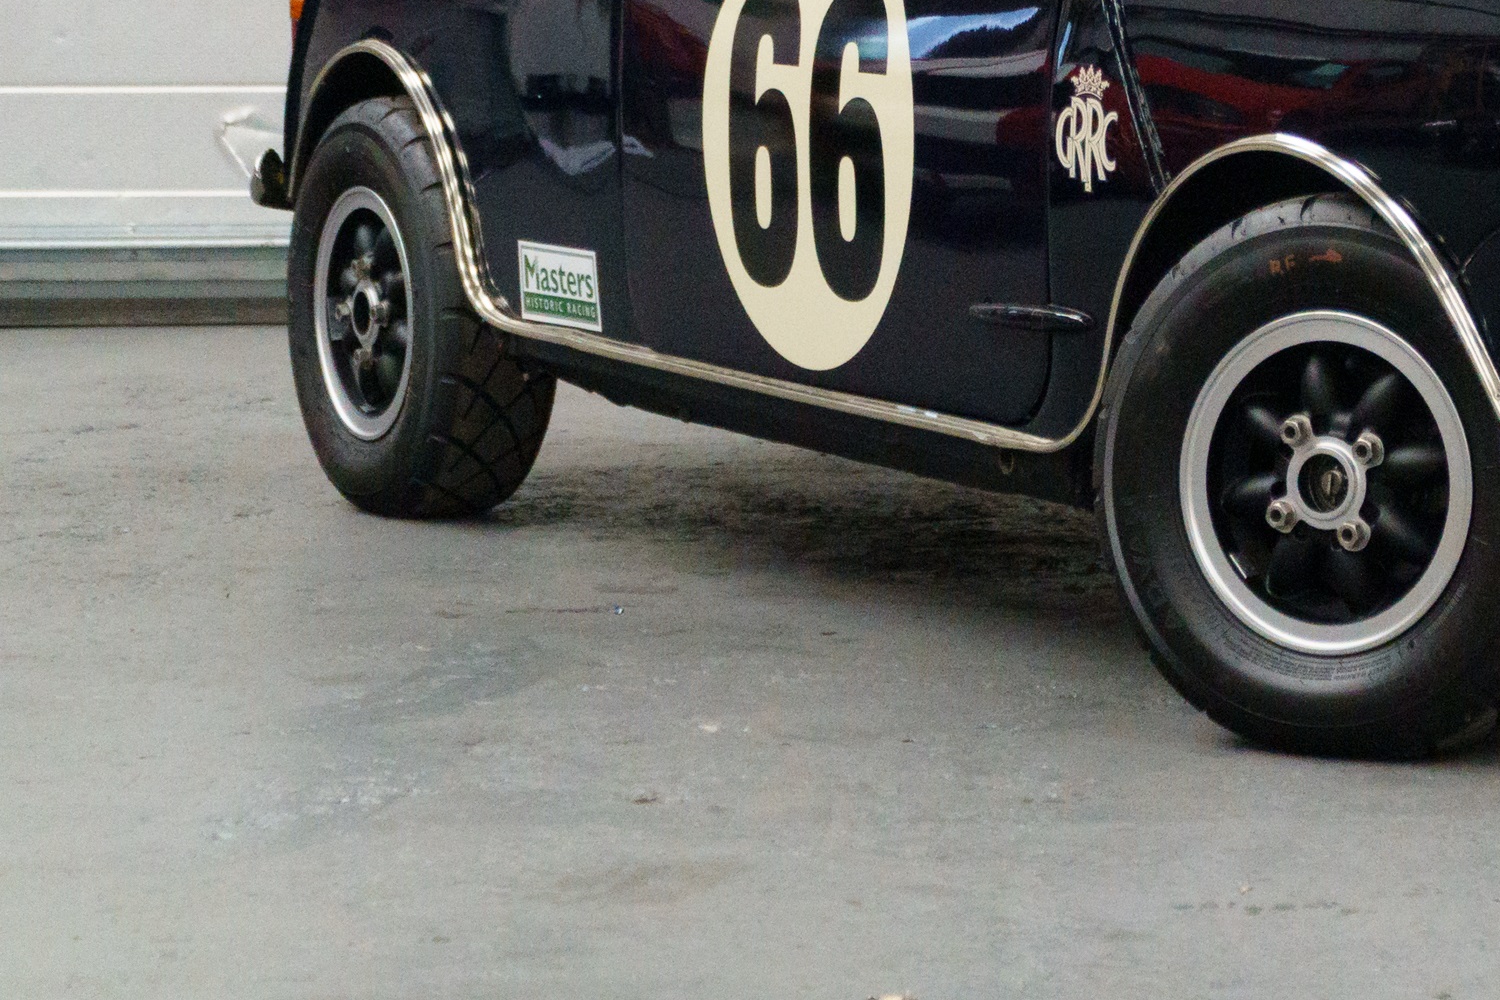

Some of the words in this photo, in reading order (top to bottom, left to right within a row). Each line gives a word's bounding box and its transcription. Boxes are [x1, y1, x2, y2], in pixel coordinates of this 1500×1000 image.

[524, 254, 594, 298] Masters
[525, 297, 564, 313] HISTORIC
[566, 302, 596, 318] RACING
